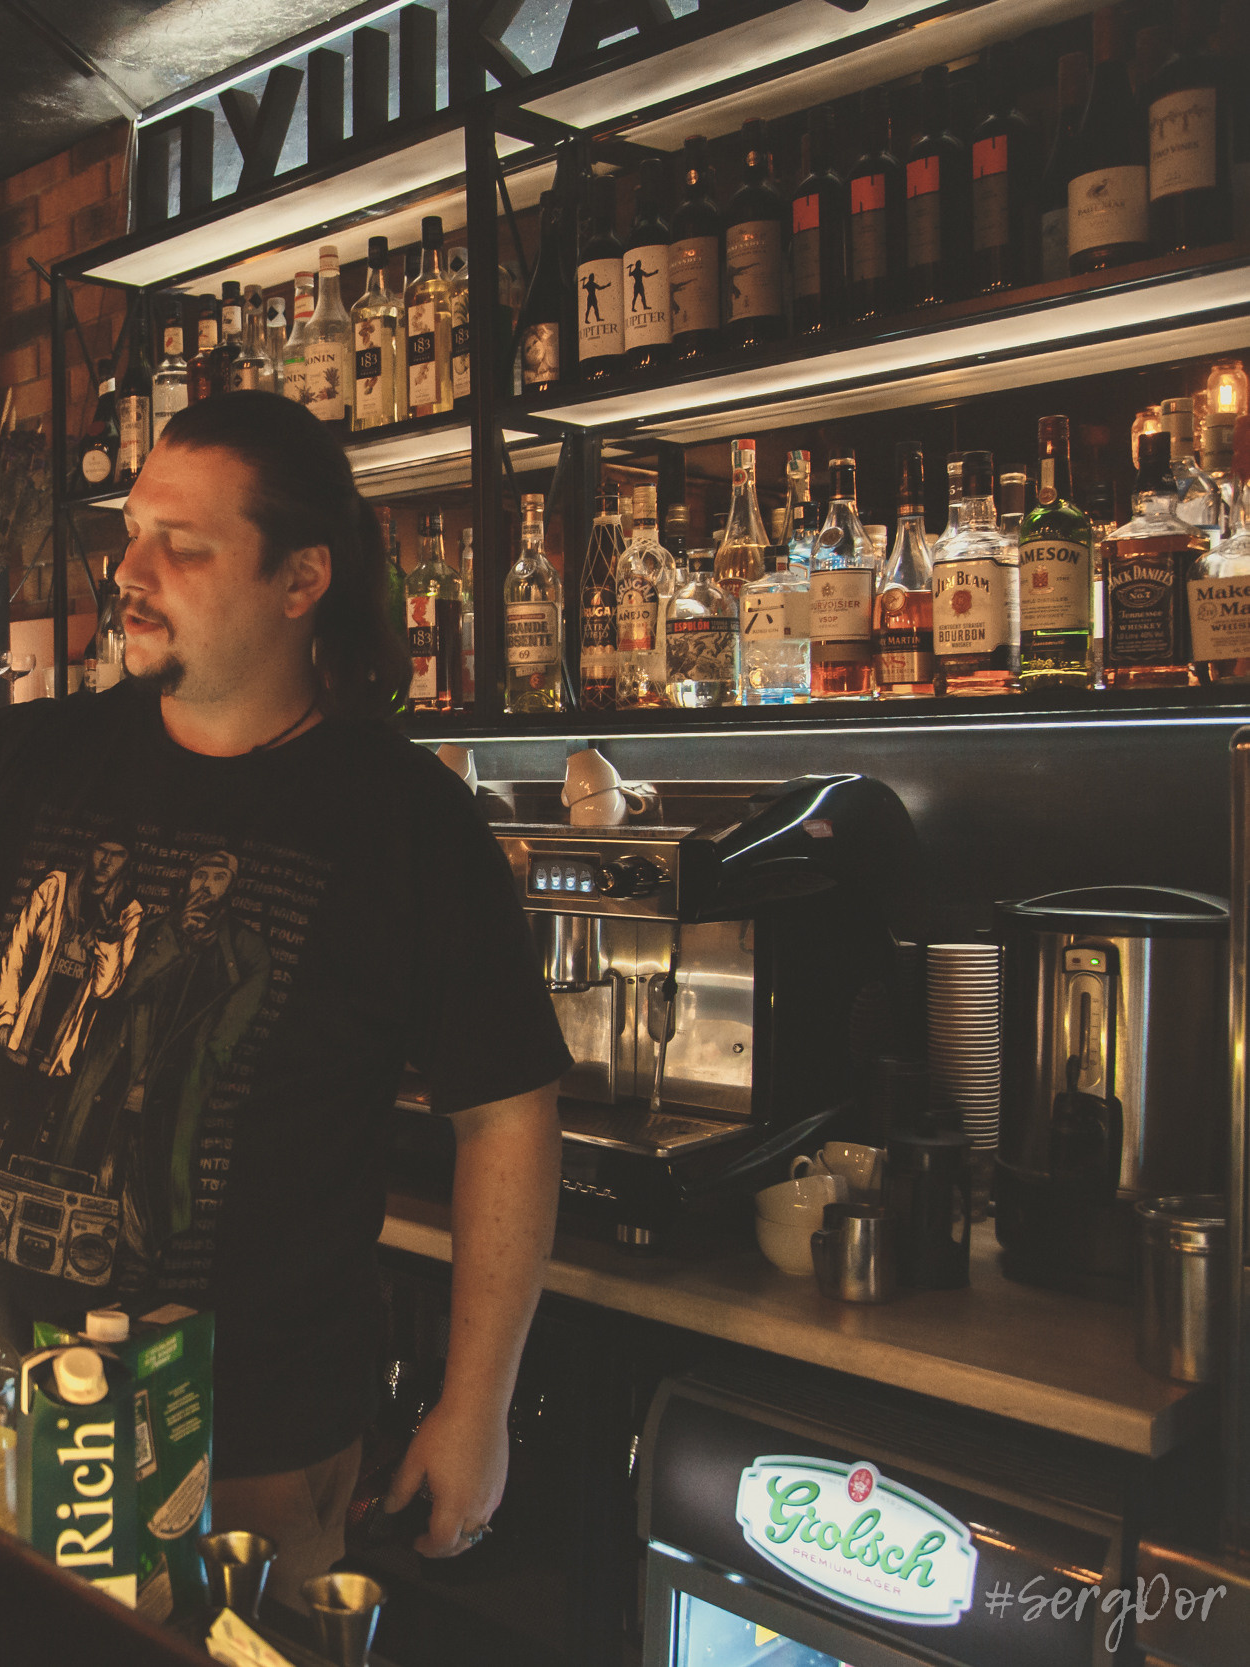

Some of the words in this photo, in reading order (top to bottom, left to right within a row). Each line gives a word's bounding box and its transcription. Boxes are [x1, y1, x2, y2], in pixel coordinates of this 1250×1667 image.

[956, 570, 991, 594] BEAM
[618, 609, 651, 622] AÑEJO
[938, 628, 986, 643] BOURBON
[56, 1418, 116, 1568] Rich
[765, 1475, 947, 1588] Grolsch
[792, 1547, 852, 1577] PREMIUM
[856, 1572, 902, 1595] LAGER
